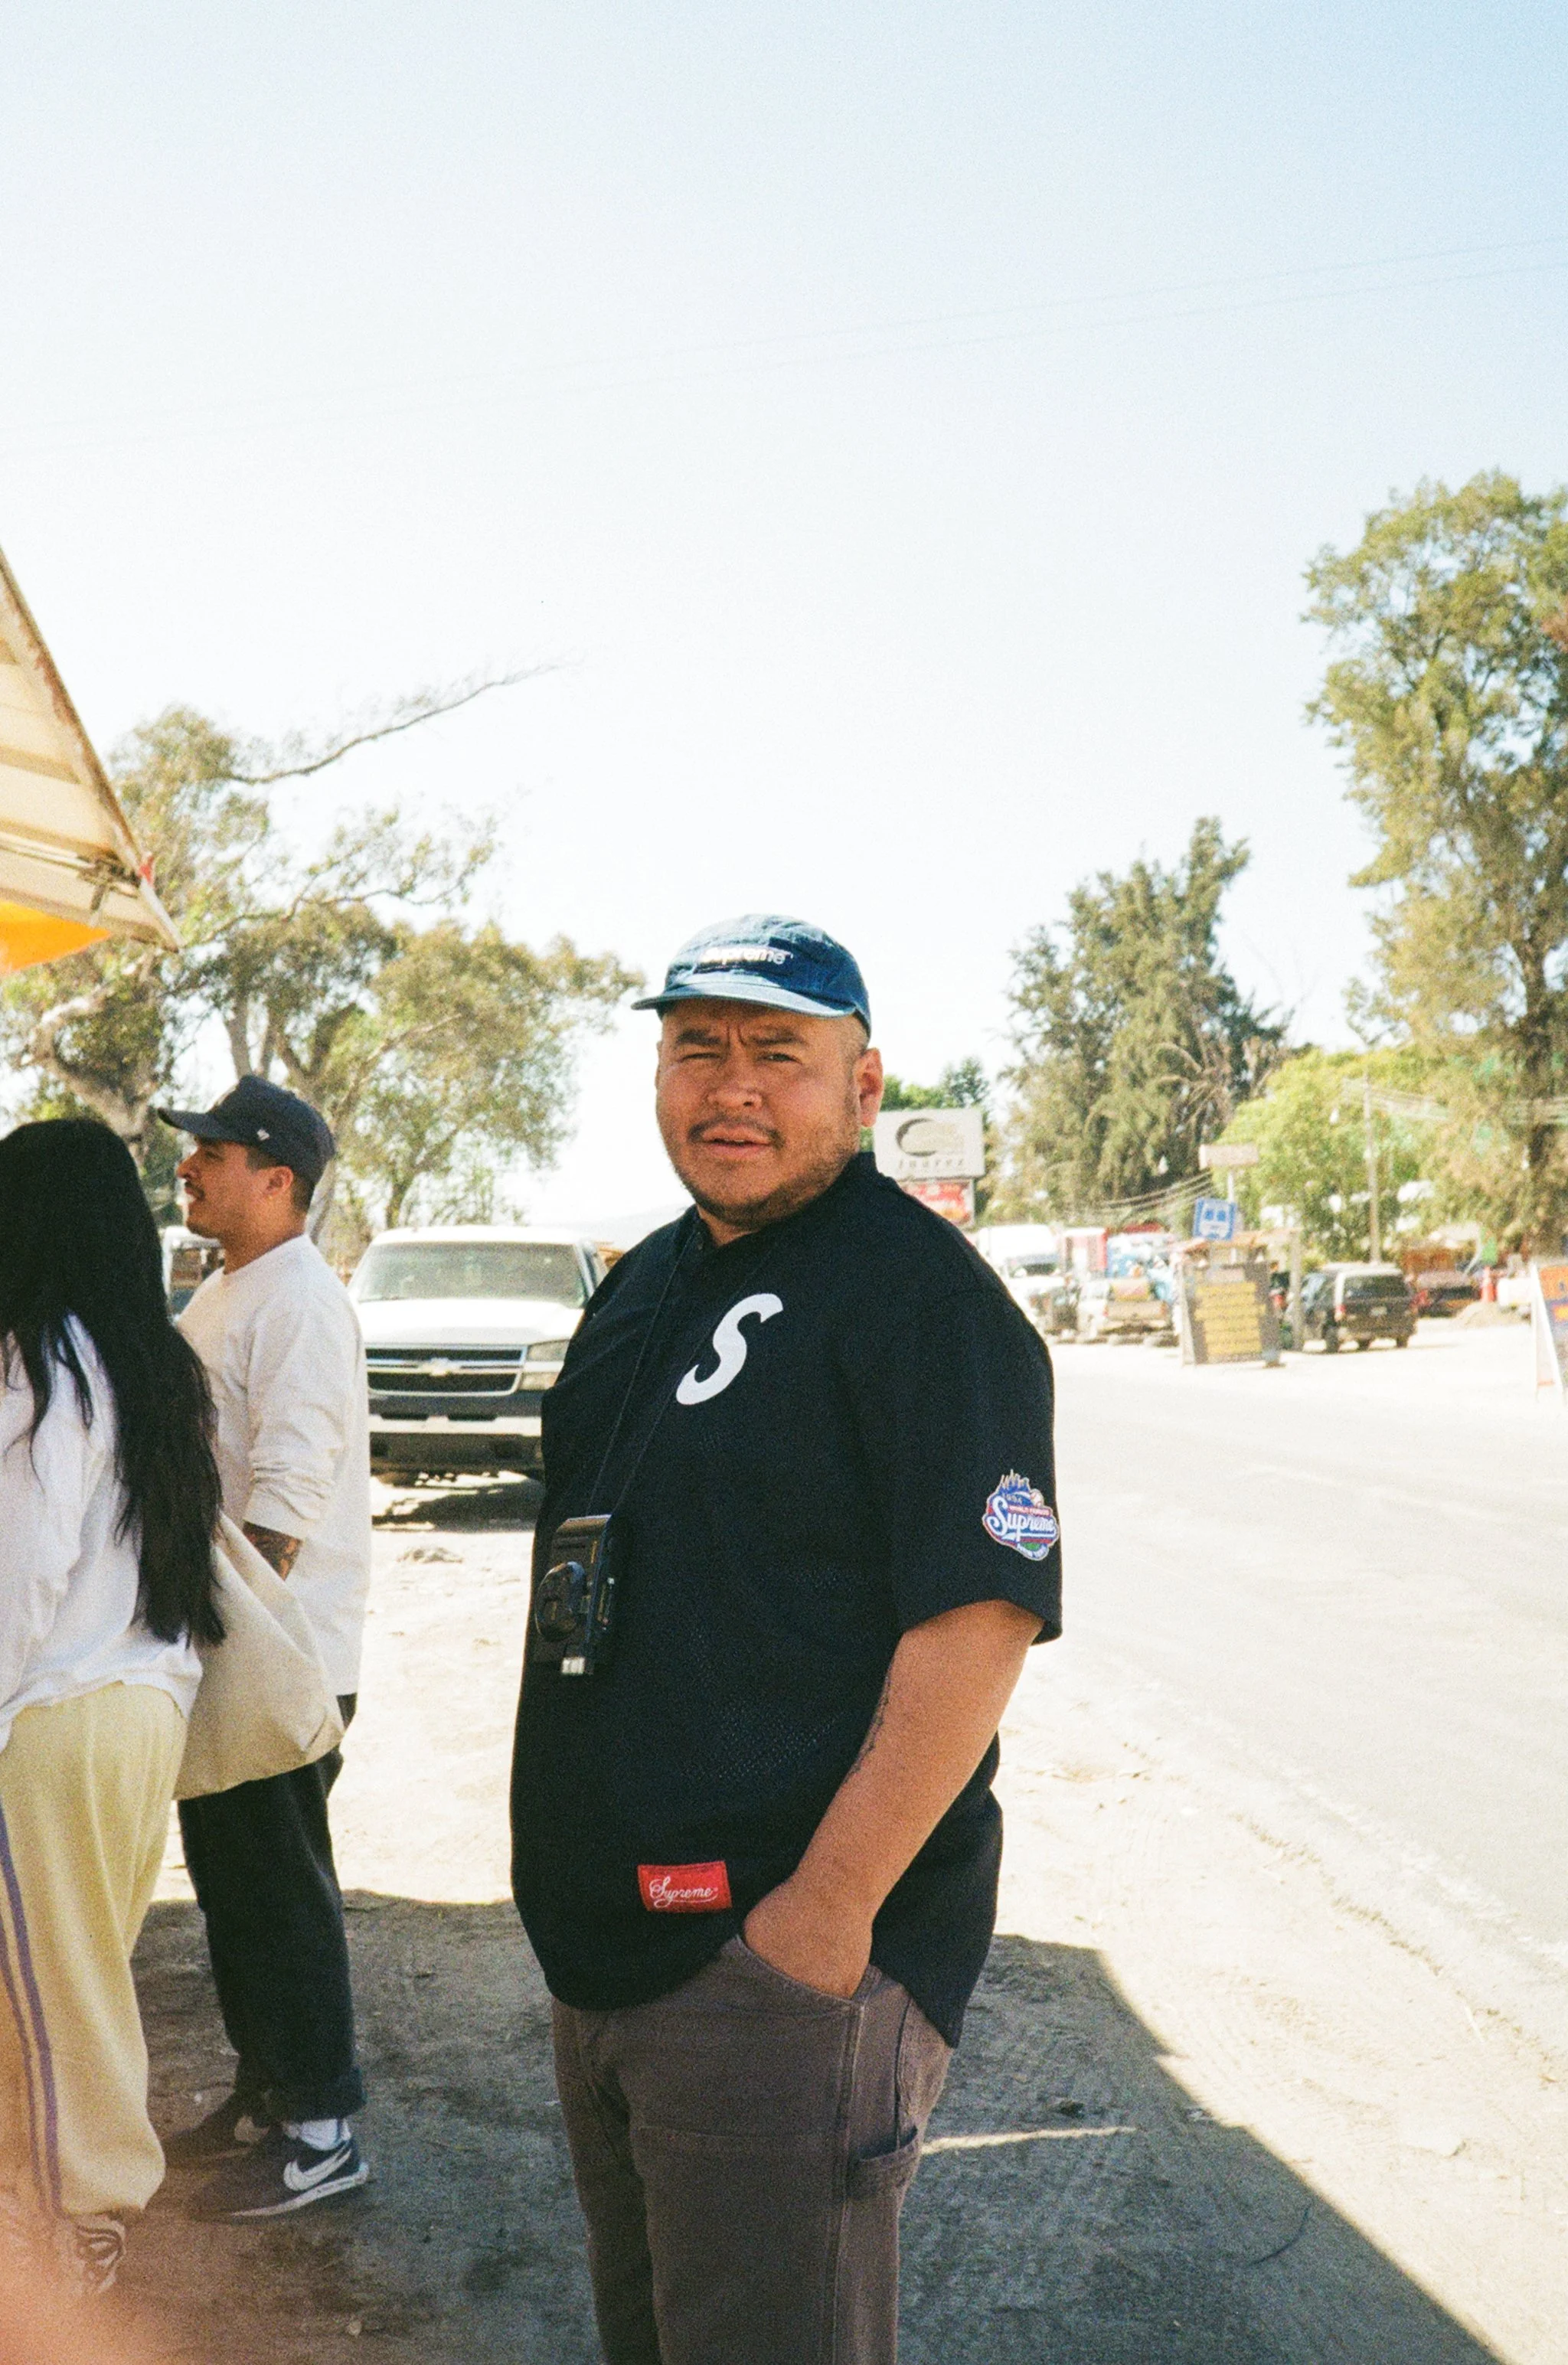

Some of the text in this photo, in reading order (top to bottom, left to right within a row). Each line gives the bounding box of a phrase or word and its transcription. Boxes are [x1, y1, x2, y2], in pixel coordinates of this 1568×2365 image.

[676, 1293, 783, 1405] S
[987, 1496, 1056, 1541] Supreme
[649, 1876, 718, 1908] Supreme
